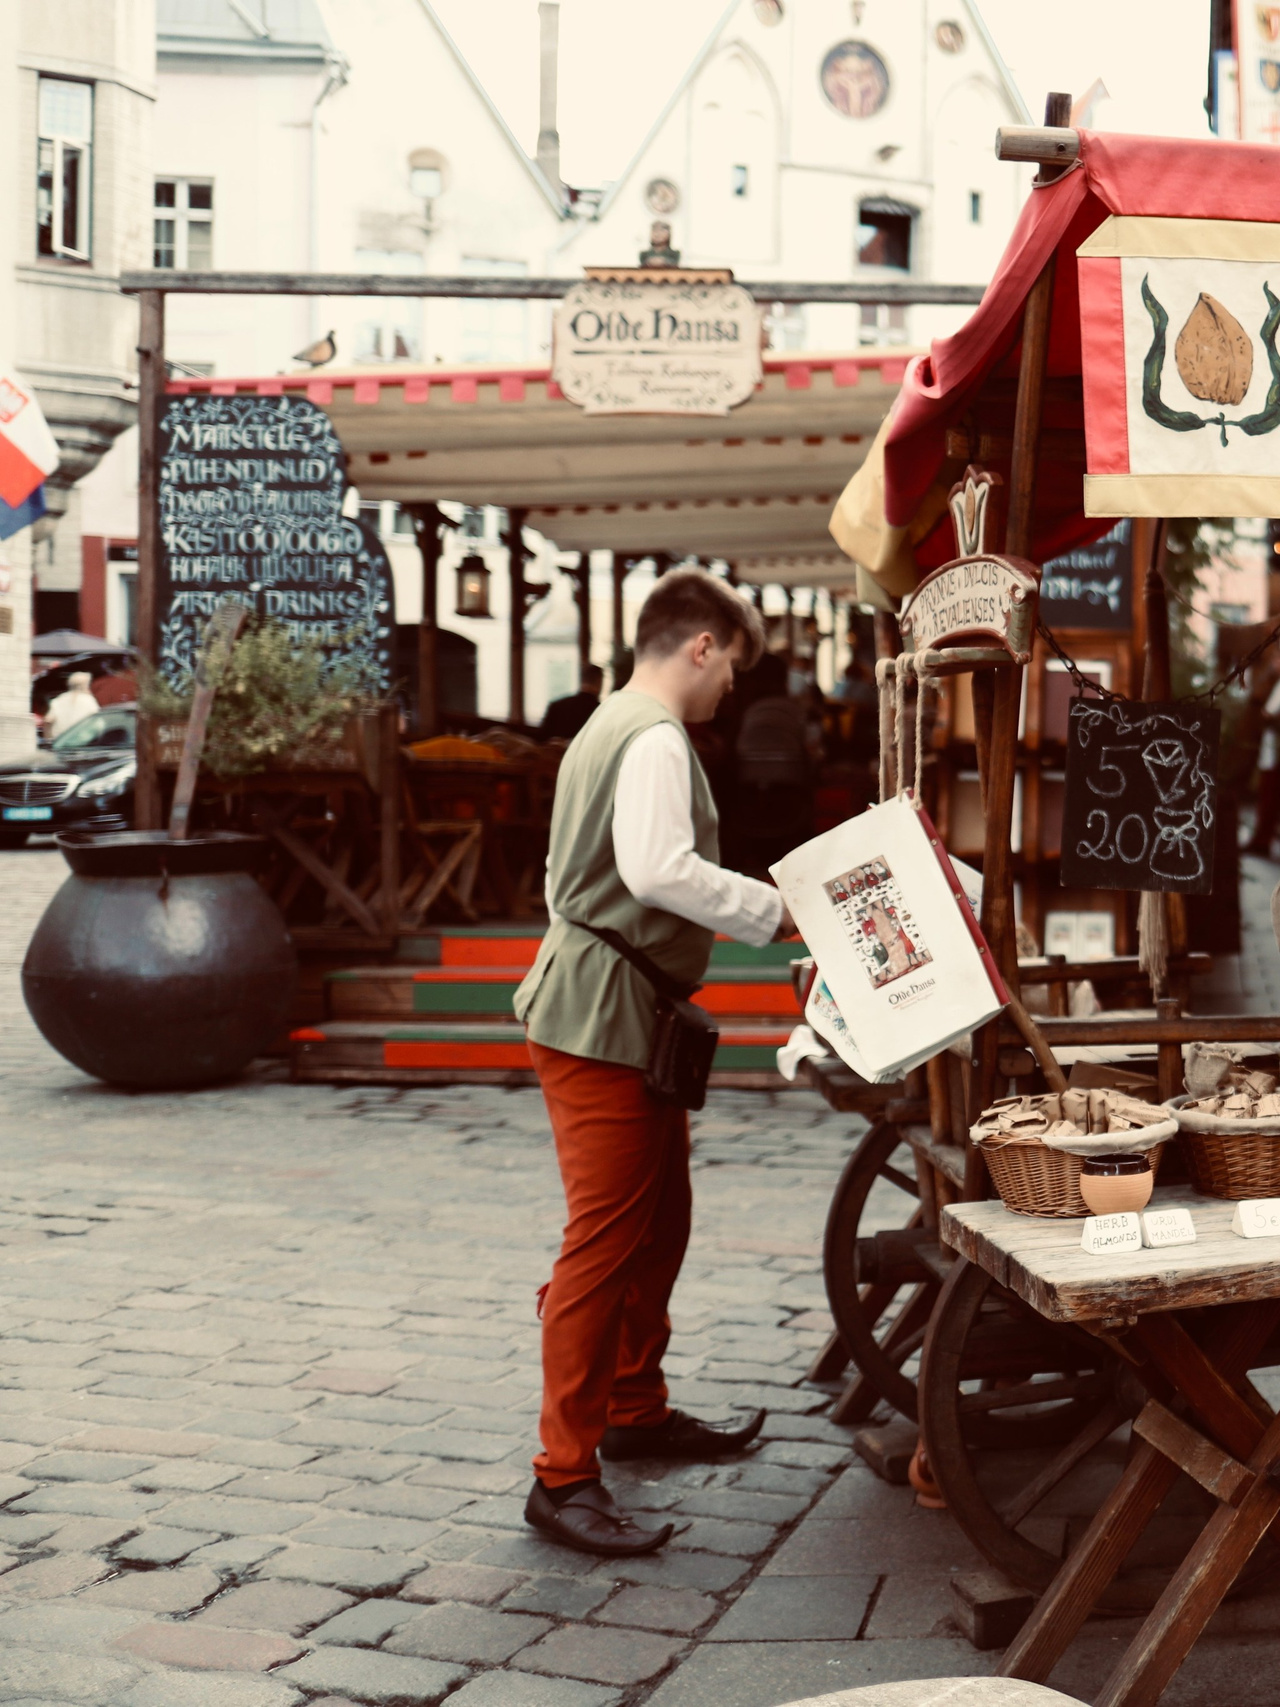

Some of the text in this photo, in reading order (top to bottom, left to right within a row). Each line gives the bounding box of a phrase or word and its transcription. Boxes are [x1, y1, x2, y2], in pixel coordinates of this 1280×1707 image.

[569, 309, 643, 342] Olde
[963, 563, 999, 589] DVLCIS
[264, 590, 360, 616] DRINKS
[1086, 744, 1141, 798] 5
[1076, 808, 1149, 864] 20
[888, 990, 910, 1005] Olde
[1094, 1215, 1129, 1231] HERB
[1151, 1227, 1194, 1241] MANDEL
[1092, 1231, 1138, 1249] ALMONDS
